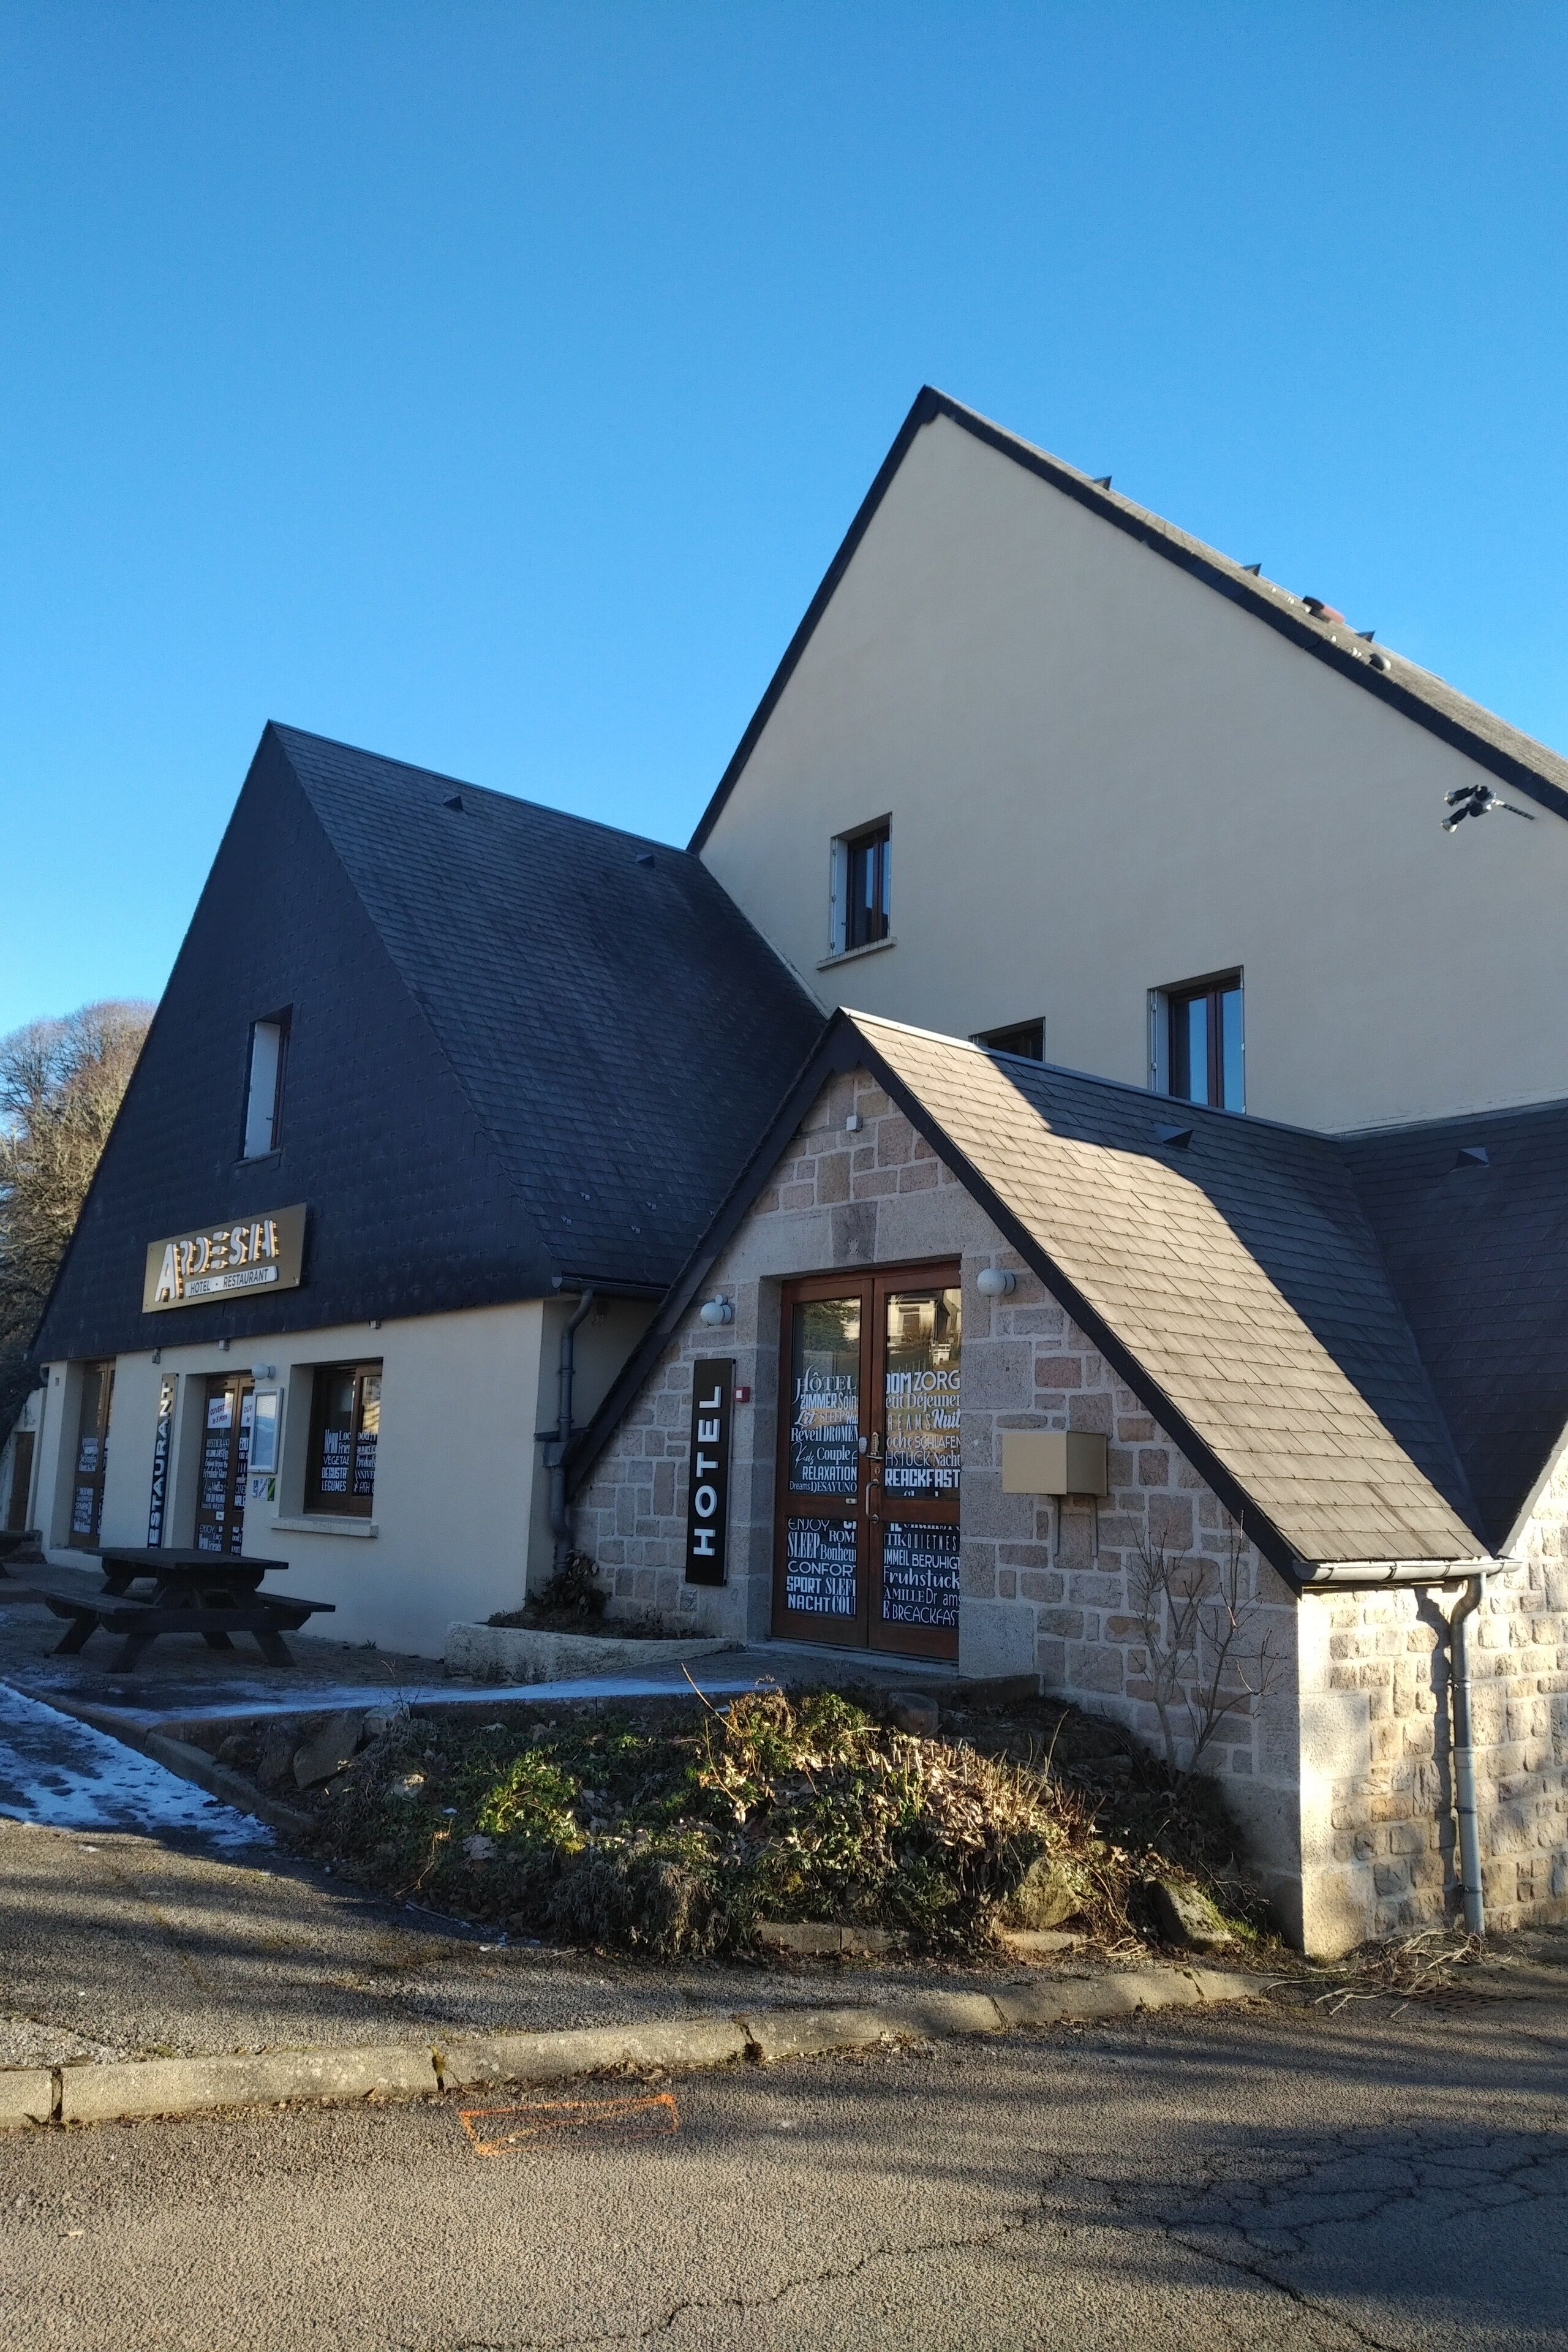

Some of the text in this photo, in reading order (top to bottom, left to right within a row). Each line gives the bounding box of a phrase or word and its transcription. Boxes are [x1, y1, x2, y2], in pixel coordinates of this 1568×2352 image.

[154, 1219, 279, 1302] ARDESIA
[190, 1268, 269, 1294] HOTEL RESTAURANT
[791, 1364, 857, 1405] HÔTEL
[913, 1370, 960, 1391] ZORG
[210, 1401, 232, 1416] OUVERTRE
[800, 1393, 837, 1409] ZIMMER
[821, 1411, 845, 1423] SLEEP
[932, 1408, 960, 1428] Nuit
[791, 1424, 822, 1442] Réveil
[791, 1441, 815, 1469] Kids
[816, 1444, 851, 1465] Couple
[933, 1449, 960, 1466] Nacht
[148, 1382, 172, 1548] ESTAURANT
[693, 1385, 722, 1556] HOTEL
[802, 1466, 858, 1481] RELAXATION
[322, 1480, 347, 1492] LEGUMES
[790, 1480, 858, 1493] Dreams DESAYUNO
[884, 1468, 960, 1488] REACKFAST
[788, 1518, 830, 1531] ENJOY
[787, 1531, 820, 1559] SLEEP
[828, 1530, 857, 1544] ROM
[884, 1532, 956, 1551] TIK QUIETNES
[786, 1575, 822, 1594] SPORT
[788, 1594, 831, 1612] NACHT
